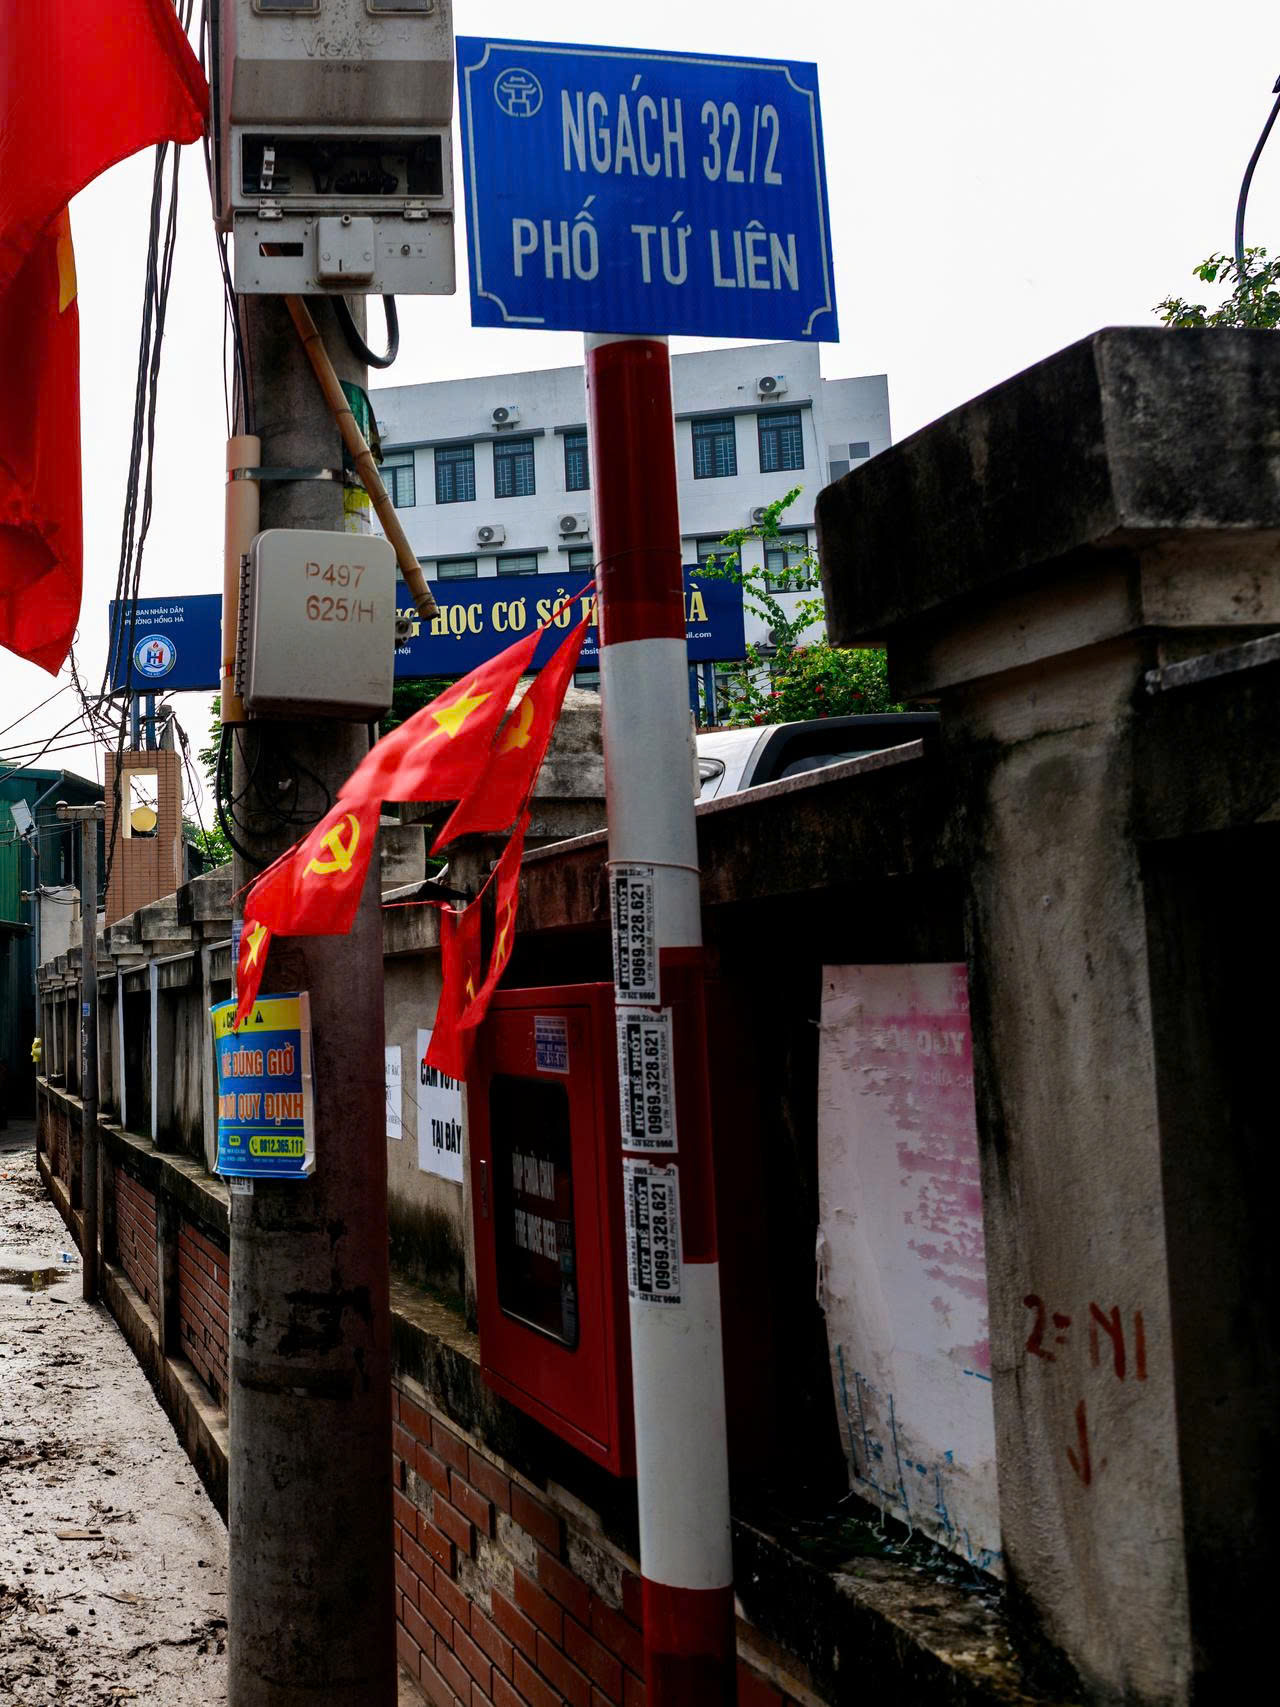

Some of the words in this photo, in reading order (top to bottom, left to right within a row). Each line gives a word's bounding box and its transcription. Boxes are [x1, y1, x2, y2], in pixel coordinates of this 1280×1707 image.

[561, 74, 686, 179] NGÁCH
[701, 101, 783, 185] 32/2
[512, 194, 600, 280] PHỐ
[631, 211, 693, 285] TỨ
[711, 219, 800, 291] LIÊN
[306, 562, 365, 589] P497
[150, 606, 168, 615] NHÂN
[169, 605, 184, 614] DÂN
[154, 615, 173, 624] HỒNG
[174, 614, 184, 623] HÀ
[306, 595, 374, 623] 625/H
[431, 604, 483, 640] HỌC
[492, 597, 527, 632] CƠ
[684, 583, 709, 622] À
[580, 648, 599, 656] ebsit
[631, 883, 645, 986] 0969.328.621
[620, 952, 629, 982] HÚT
[232, 1044, 263, 1077] ĐÚNG
[267, 1042, 295, 1076] GIỜ
[644, 1030, 662, 1134] 0969.328.621
[238, 1093, 261, 1123] QUY
[264, 1092, 304, 1126] ĐỊNH
[633, 1098, 644, 1130] HÚT
[431, 1119, 443, 1154] TẠI
[651, 1183, 670, 1290] 0969.328.621
[640, 1252, 651, 1284] HÚT
